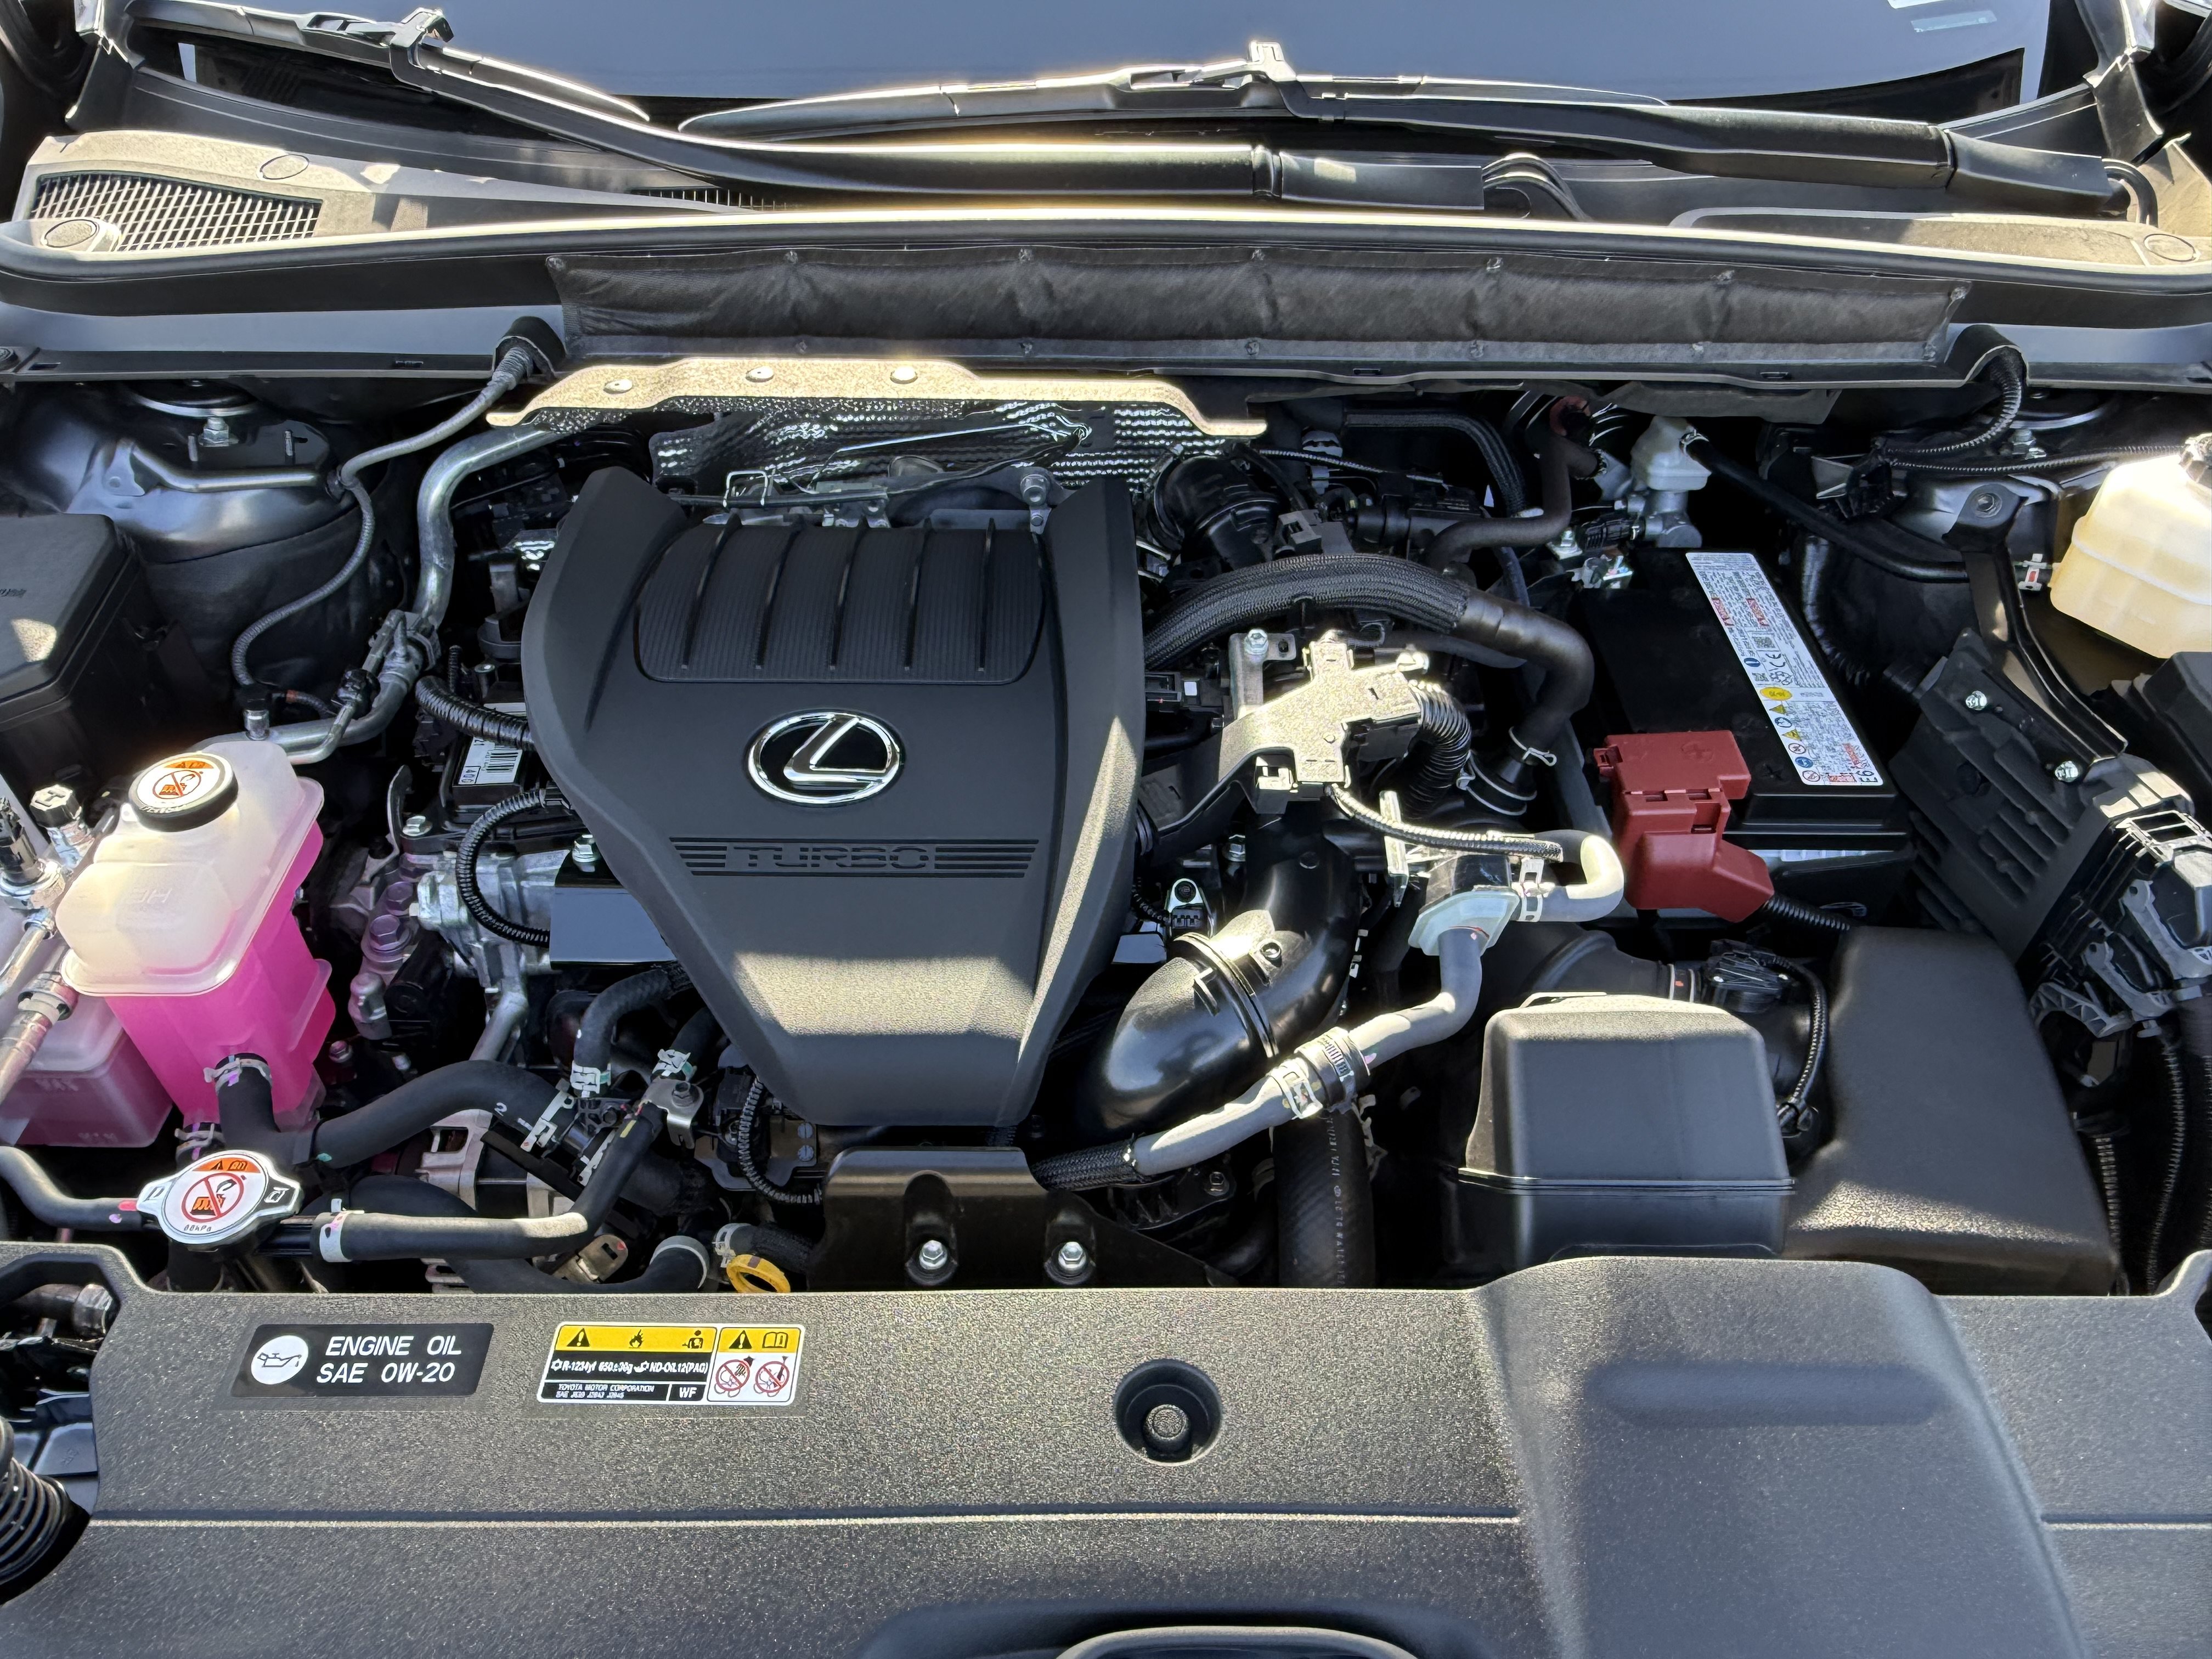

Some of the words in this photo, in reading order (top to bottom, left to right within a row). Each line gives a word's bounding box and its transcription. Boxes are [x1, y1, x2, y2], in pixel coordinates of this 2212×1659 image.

[733, 845, 929, 870] TURBO
[494, 1102, 507, 1116] 2
[325, 1335, 414, 1356] ENGINE
[426, 1335, 461, 1356] OIL
[316, 1362, 368, 1383] SAE
[380, 1362, 456, 1383] 0W-20
[679, 1387, 697, 1398] WF
